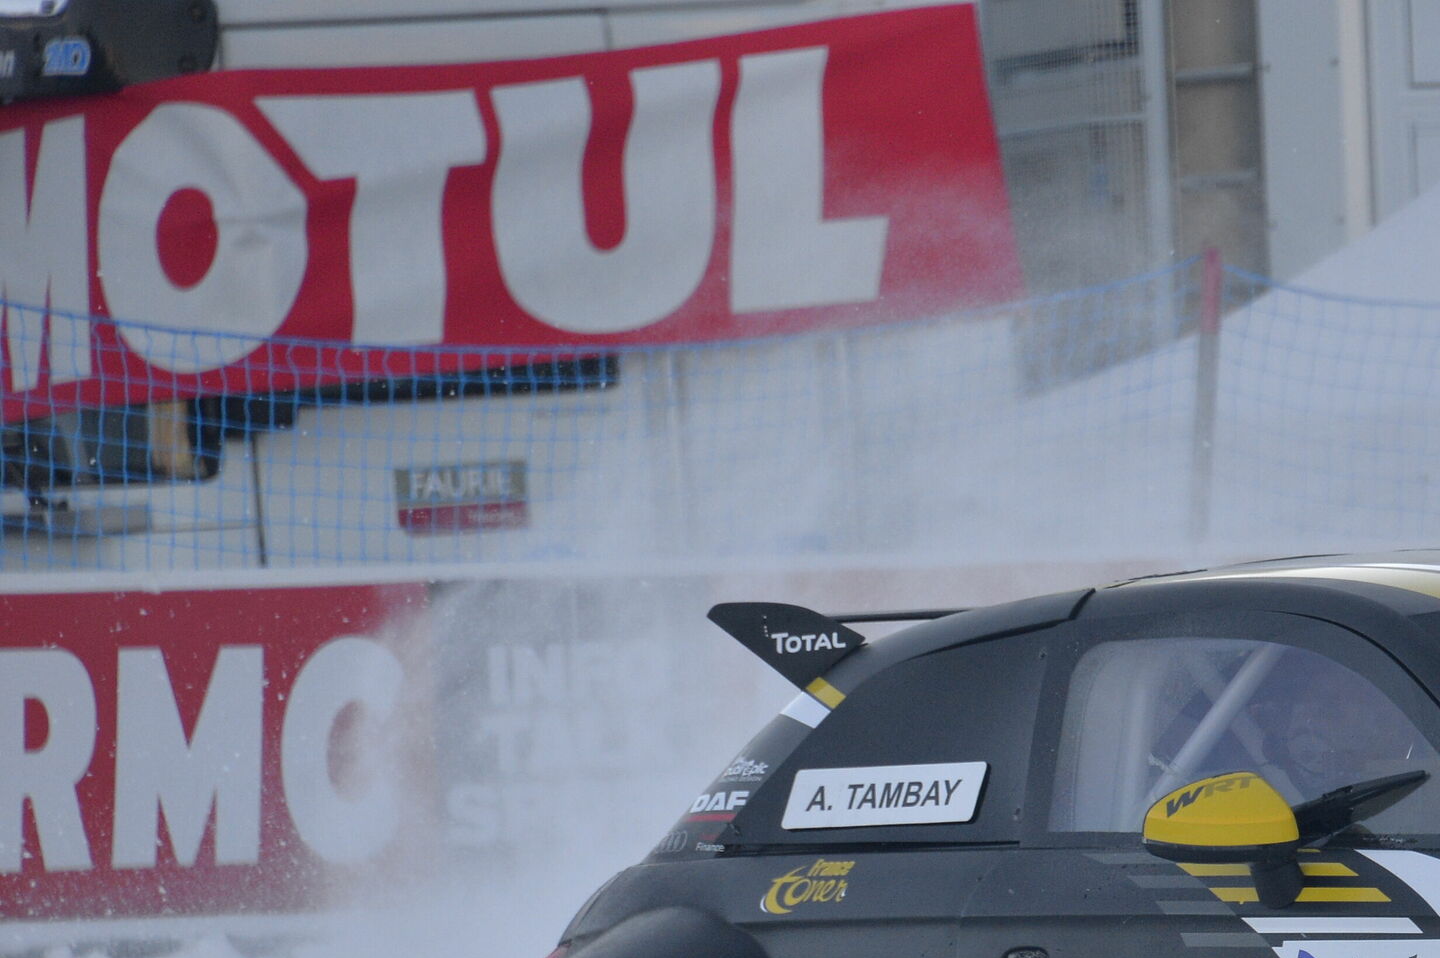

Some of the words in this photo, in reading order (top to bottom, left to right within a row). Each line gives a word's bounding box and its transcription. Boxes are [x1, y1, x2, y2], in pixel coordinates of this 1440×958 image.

[0, 45, 889, 392] MOTUL
[690, 790, 750, 813] DAF
[805, 786, 832, 812] A.
[847, 779, 963, 809] TAMBAY
[1166, 776, 1261, 818] WRT
